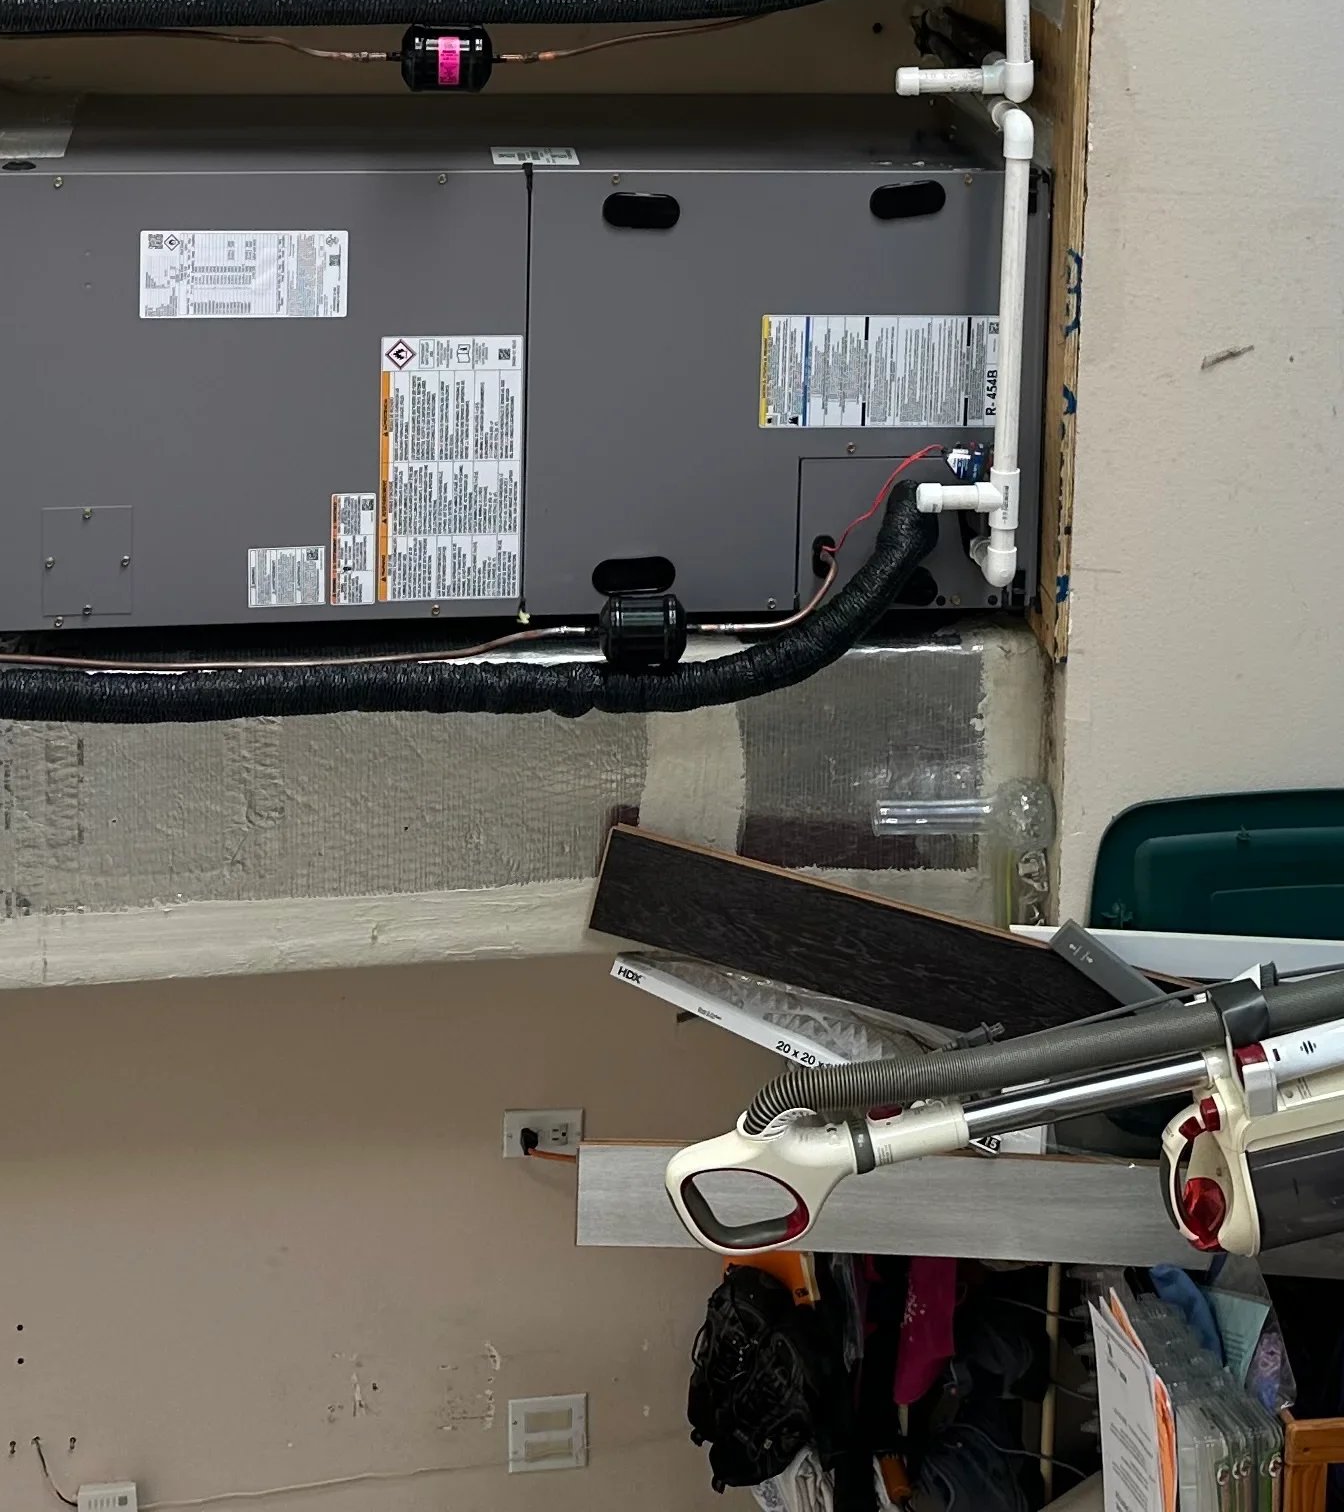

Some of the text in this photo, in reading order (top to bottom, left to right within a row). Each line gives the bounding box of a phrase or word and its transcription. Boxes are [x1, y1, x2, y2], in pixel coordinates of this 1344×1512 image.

[617, 966, 643, 984] HDX
[776, 1041, 790, 1054] 20
[802, 1052, 817, 1065] 20
